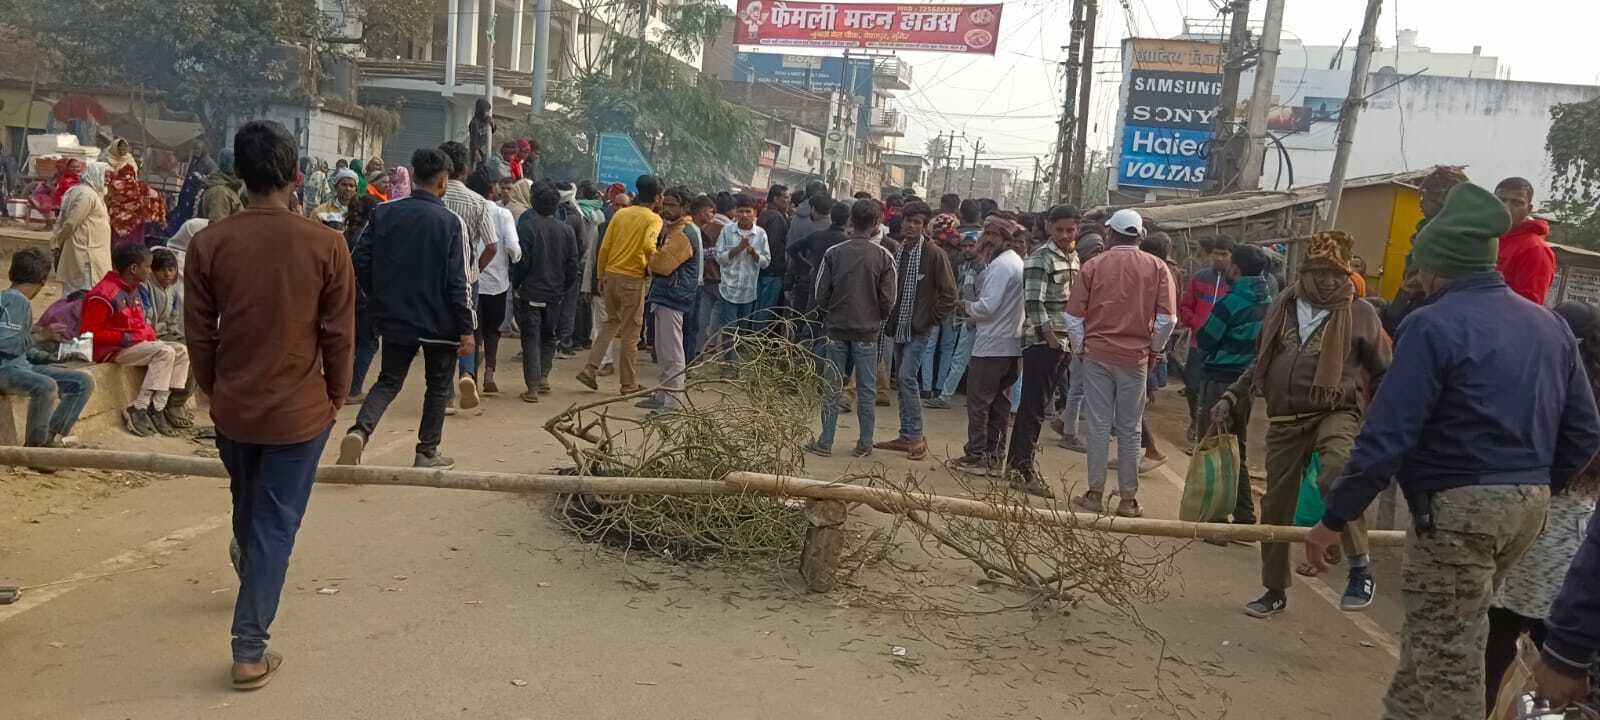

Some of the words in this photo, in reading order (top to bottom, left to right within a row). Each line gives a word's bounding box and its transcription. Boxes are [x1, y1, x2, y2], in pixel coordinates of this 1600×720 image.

[771, 1, 838, 30] फैमली
[843, 9, 896, 30] मटन
[900, 11, 960, 32] हाउस
[1135, 77, 1222, 95] SAMSUNG
[1133, 106, 1212, 124] SONY
[1126, 162, 1206, 182] VOLTAS
